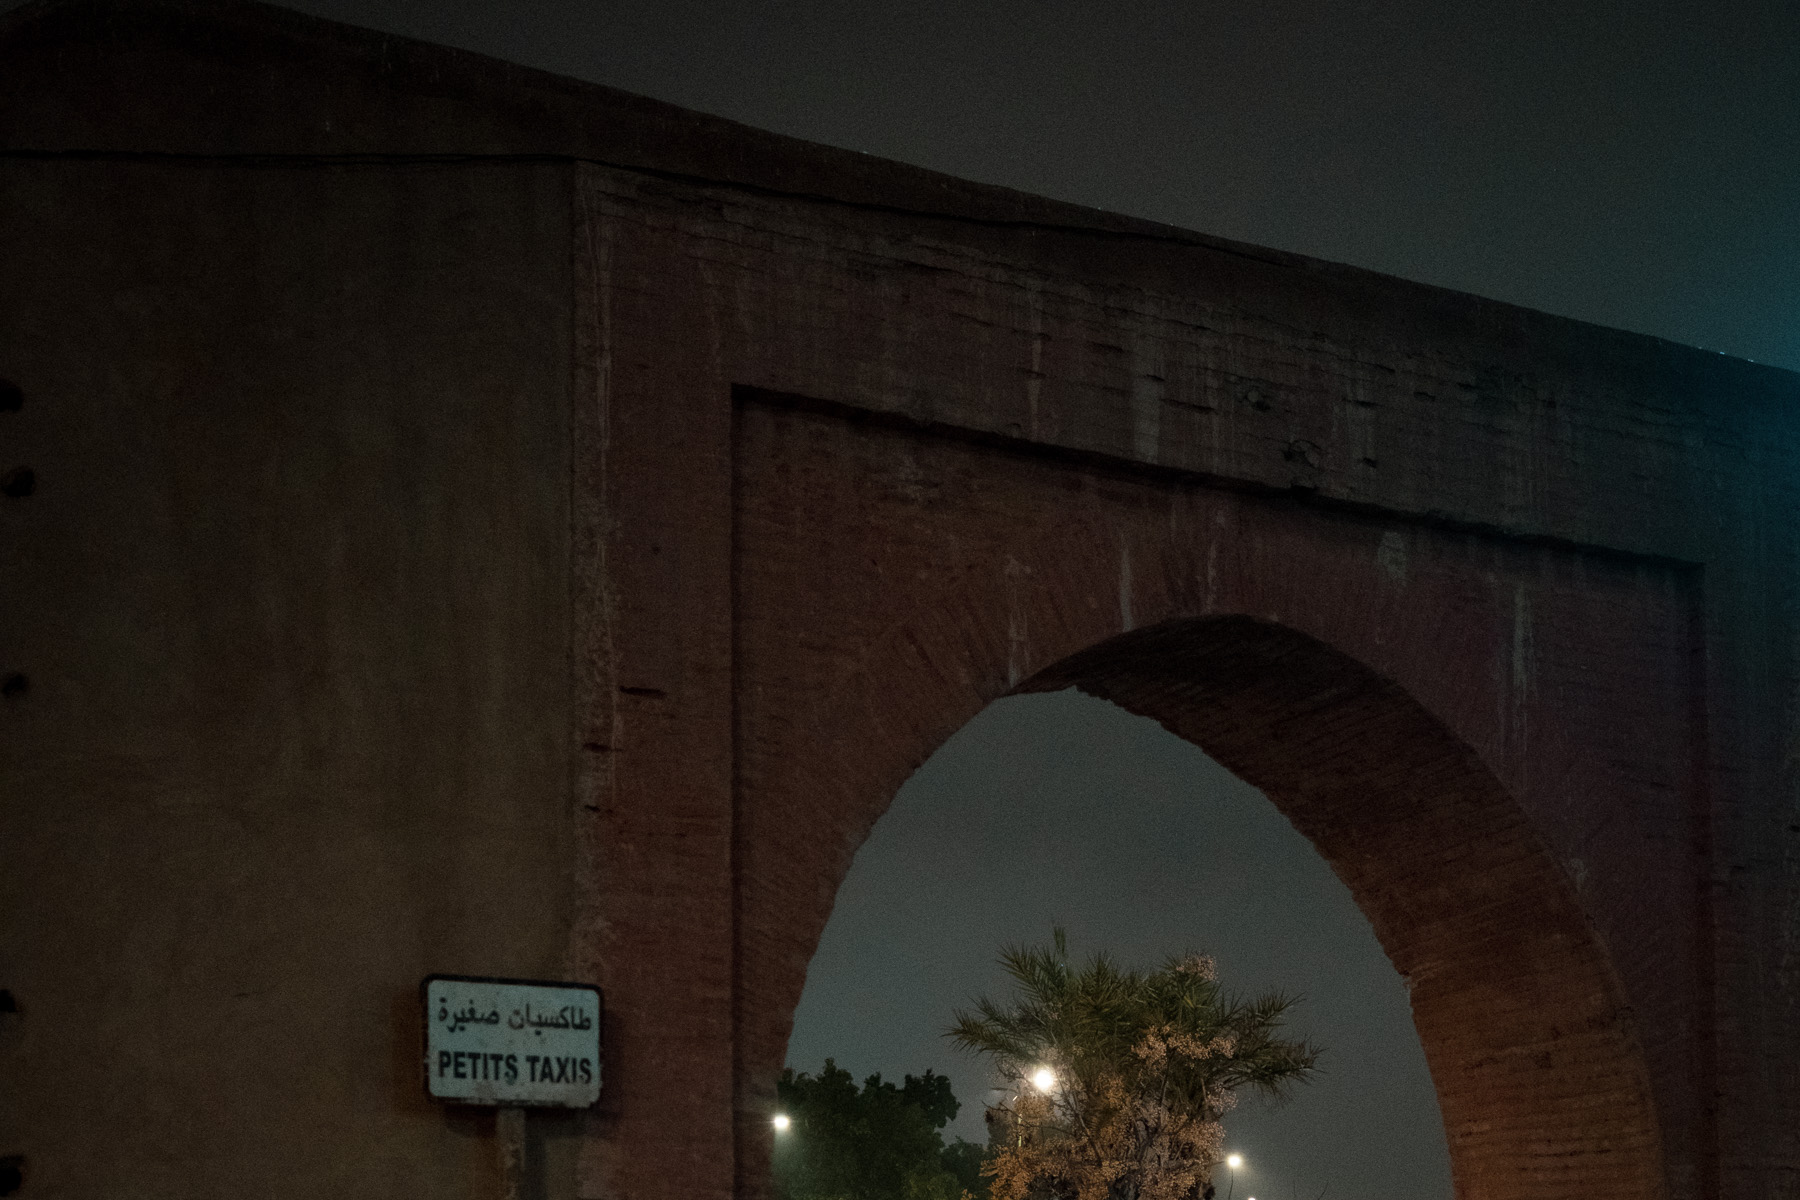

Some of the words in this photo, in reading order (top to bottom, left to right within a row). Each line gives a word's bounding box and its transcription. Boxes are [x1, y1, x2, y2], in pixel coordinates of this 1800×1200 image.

[438, 997, 500, 1033] صغيرة
[438, 1050, 518, 1081] PETITS
[526, 1055, 592, 1084] TAXIS
